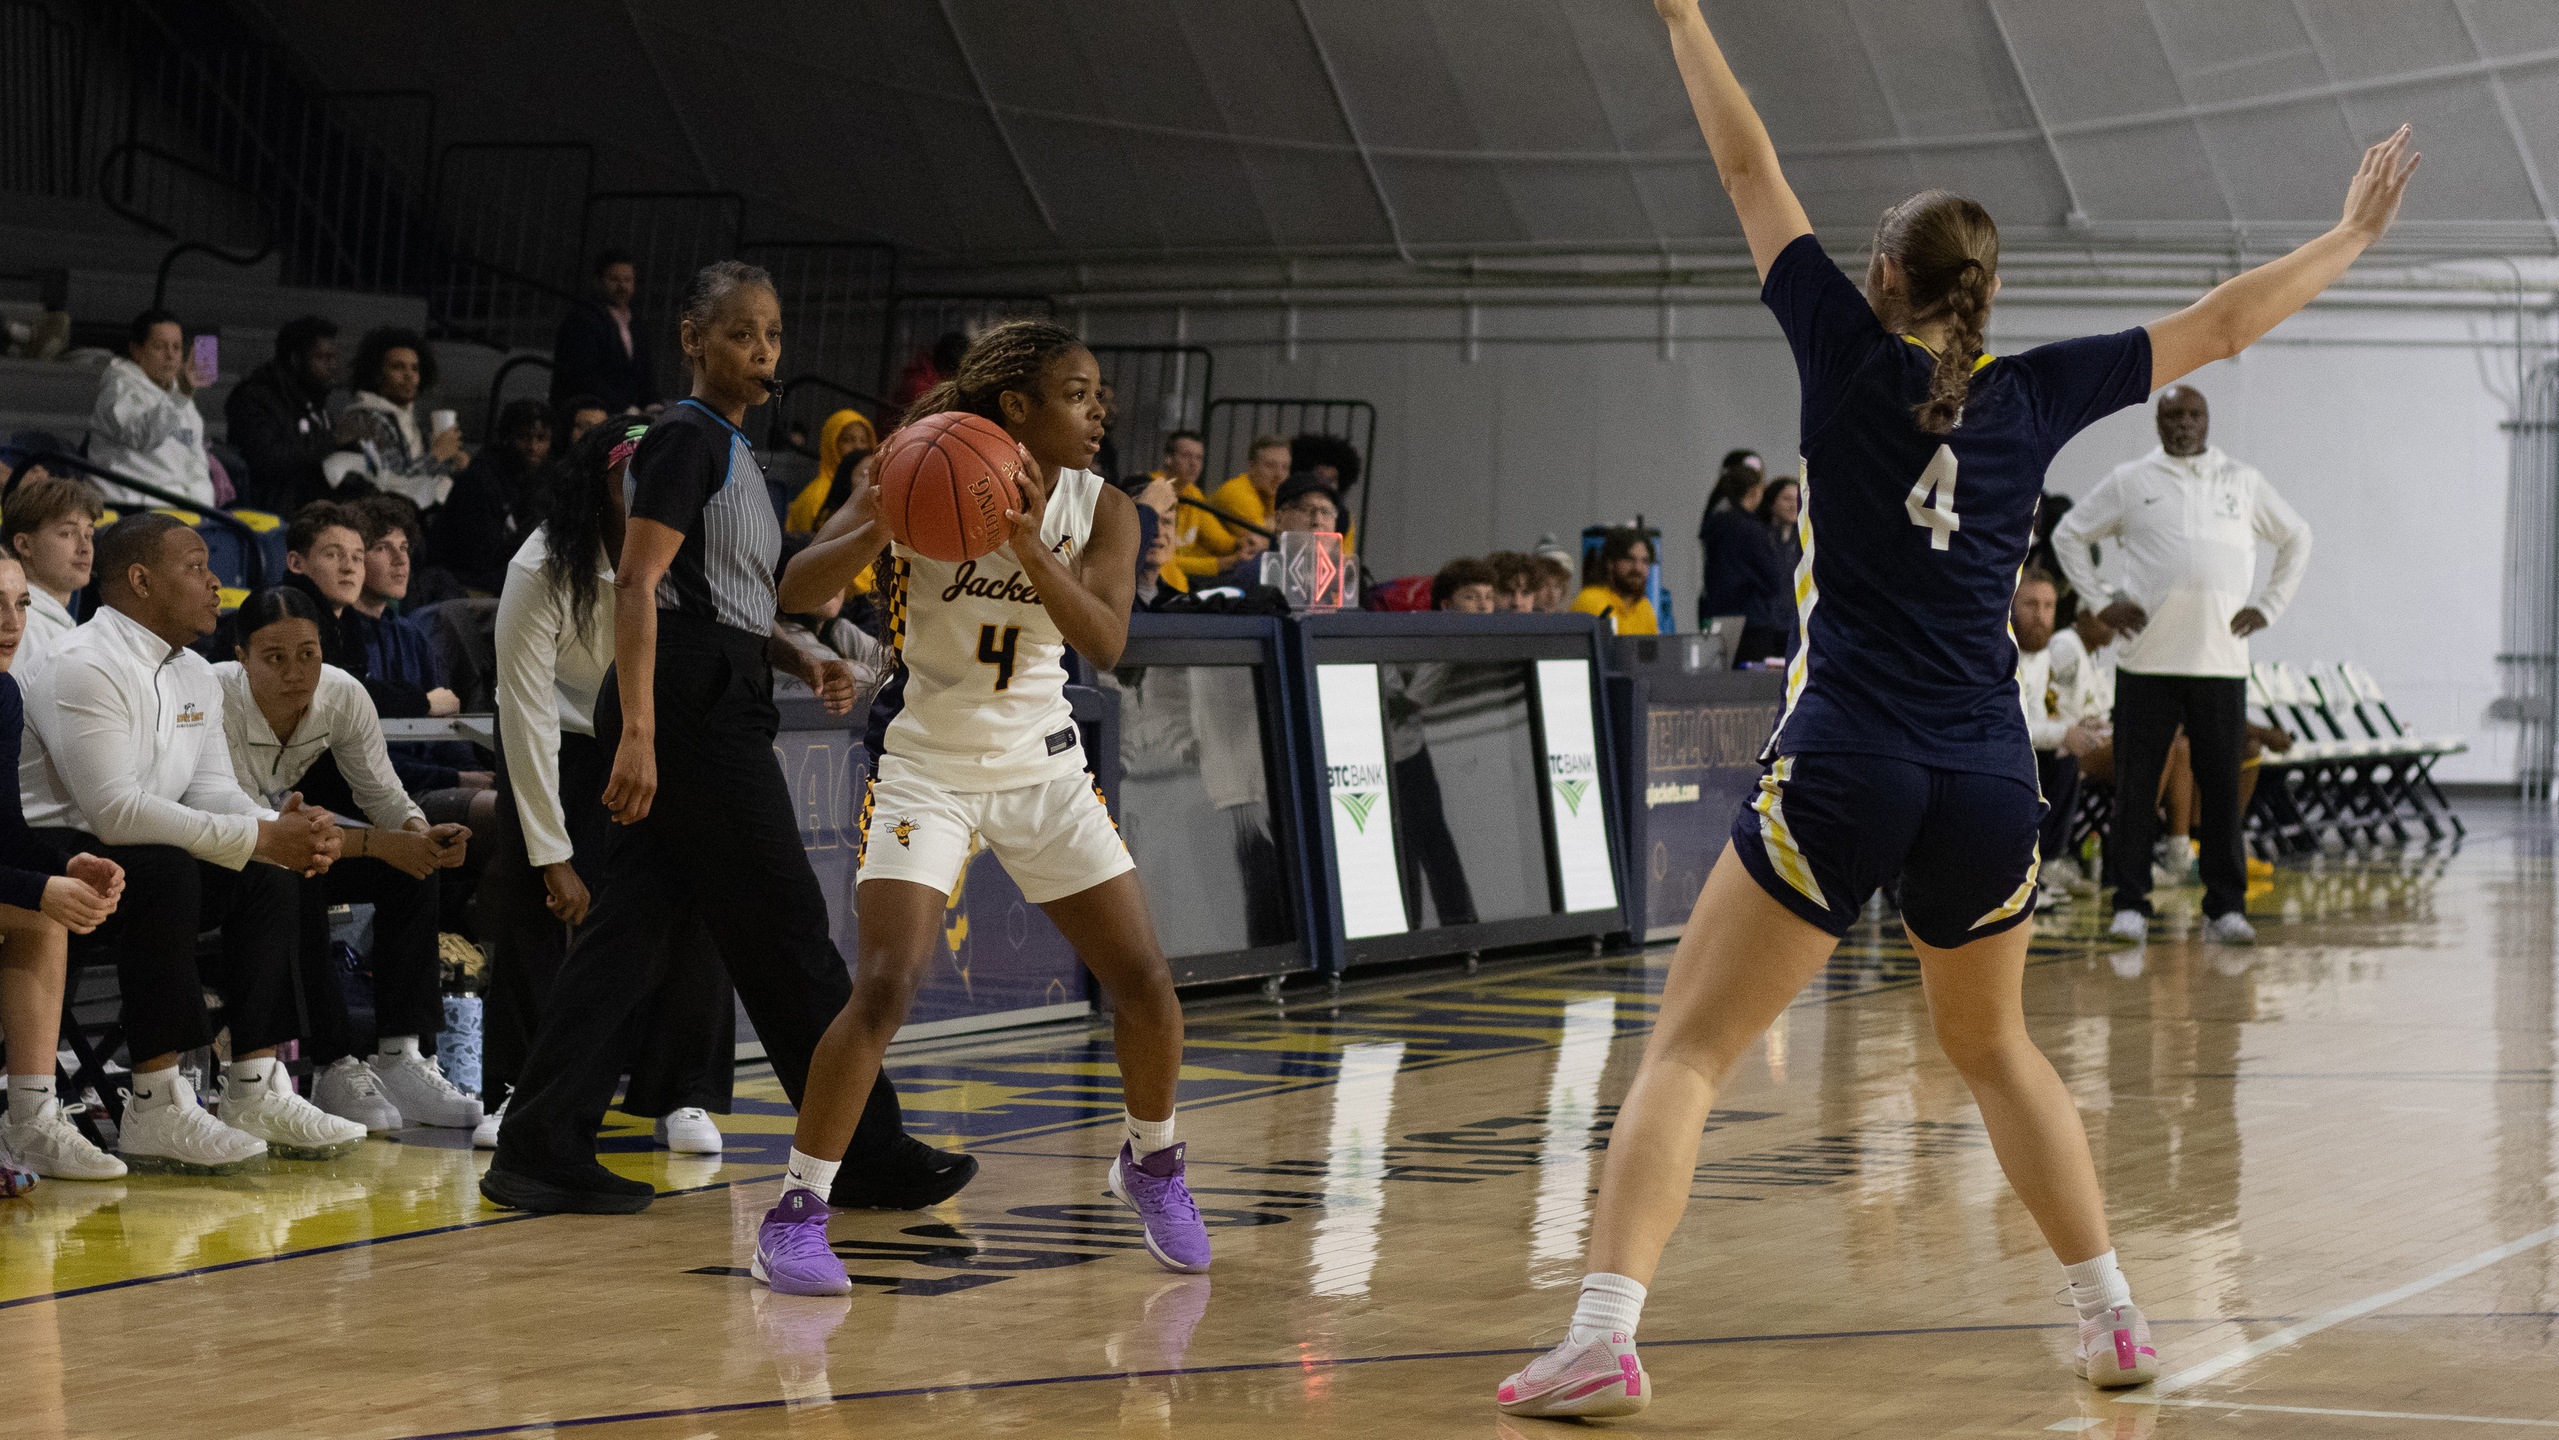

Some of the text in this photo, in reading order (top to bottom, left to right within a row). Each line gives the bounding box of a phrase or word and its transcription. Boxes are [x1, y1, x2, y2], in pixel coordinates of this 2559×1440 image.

[1904, 443, 1960, 551] 4
[941, 559, 1043, 605] Jacke
[976, 623, 1021, 693] 4
